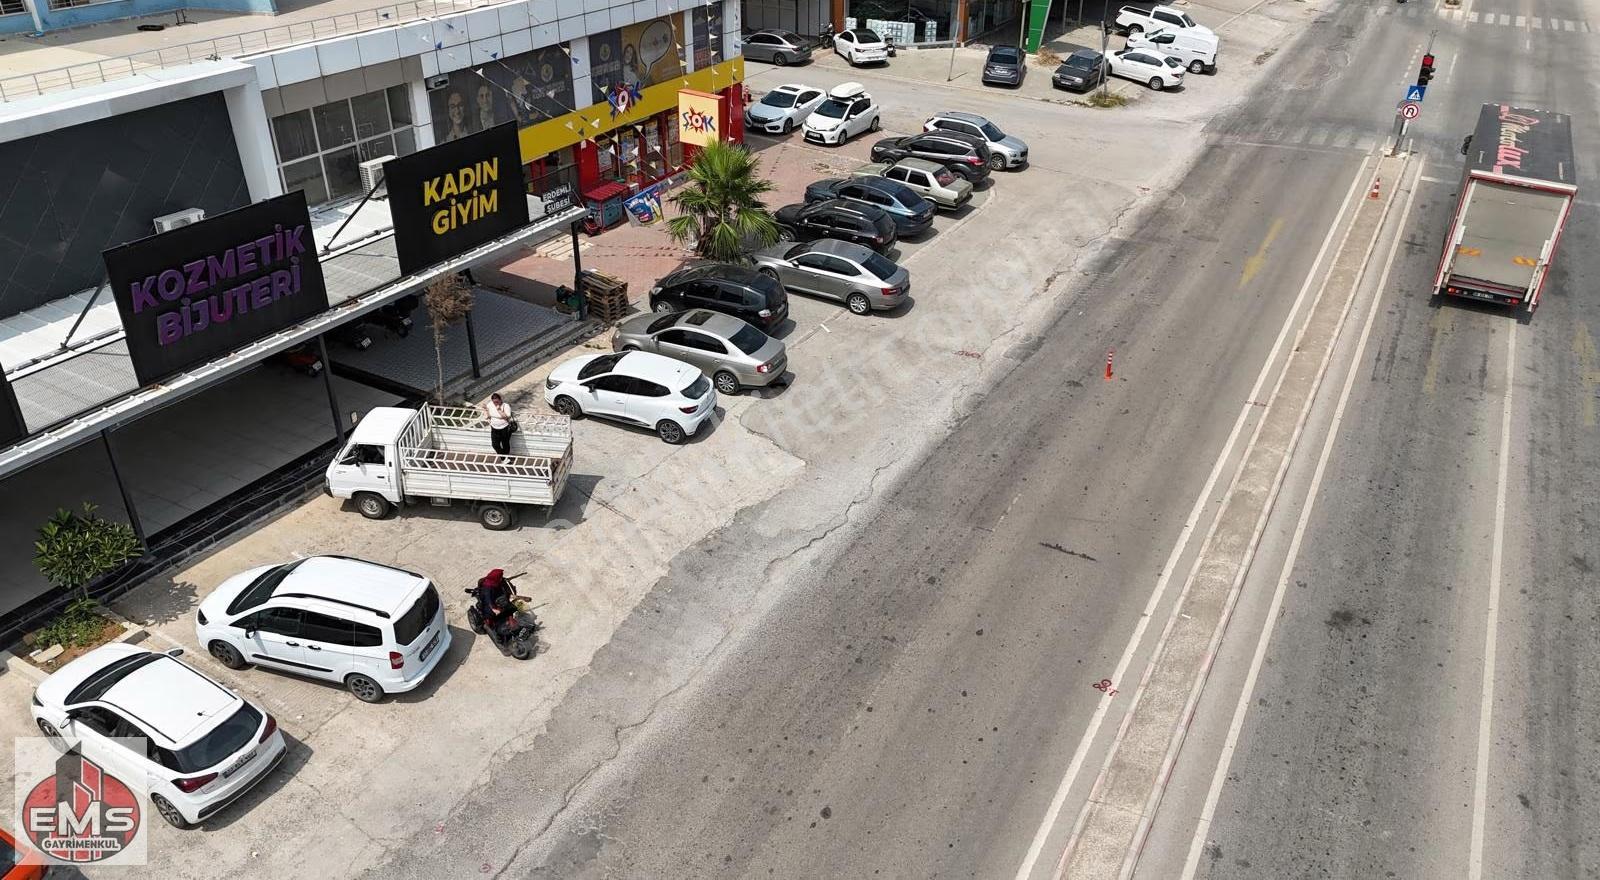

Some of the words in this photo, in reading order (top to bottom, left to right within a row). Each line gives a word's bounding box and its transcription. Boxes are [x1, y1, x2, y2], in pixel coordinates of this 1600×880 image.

[682, 104, 716, 134] ŞOK
[422, 157, 499, 207] KADIN
[432, 189, 499, 236] GİYİM
[131, 223, 306, 313] KOZMETİK
[156, 256, 302, 346] BİJUTERİ
